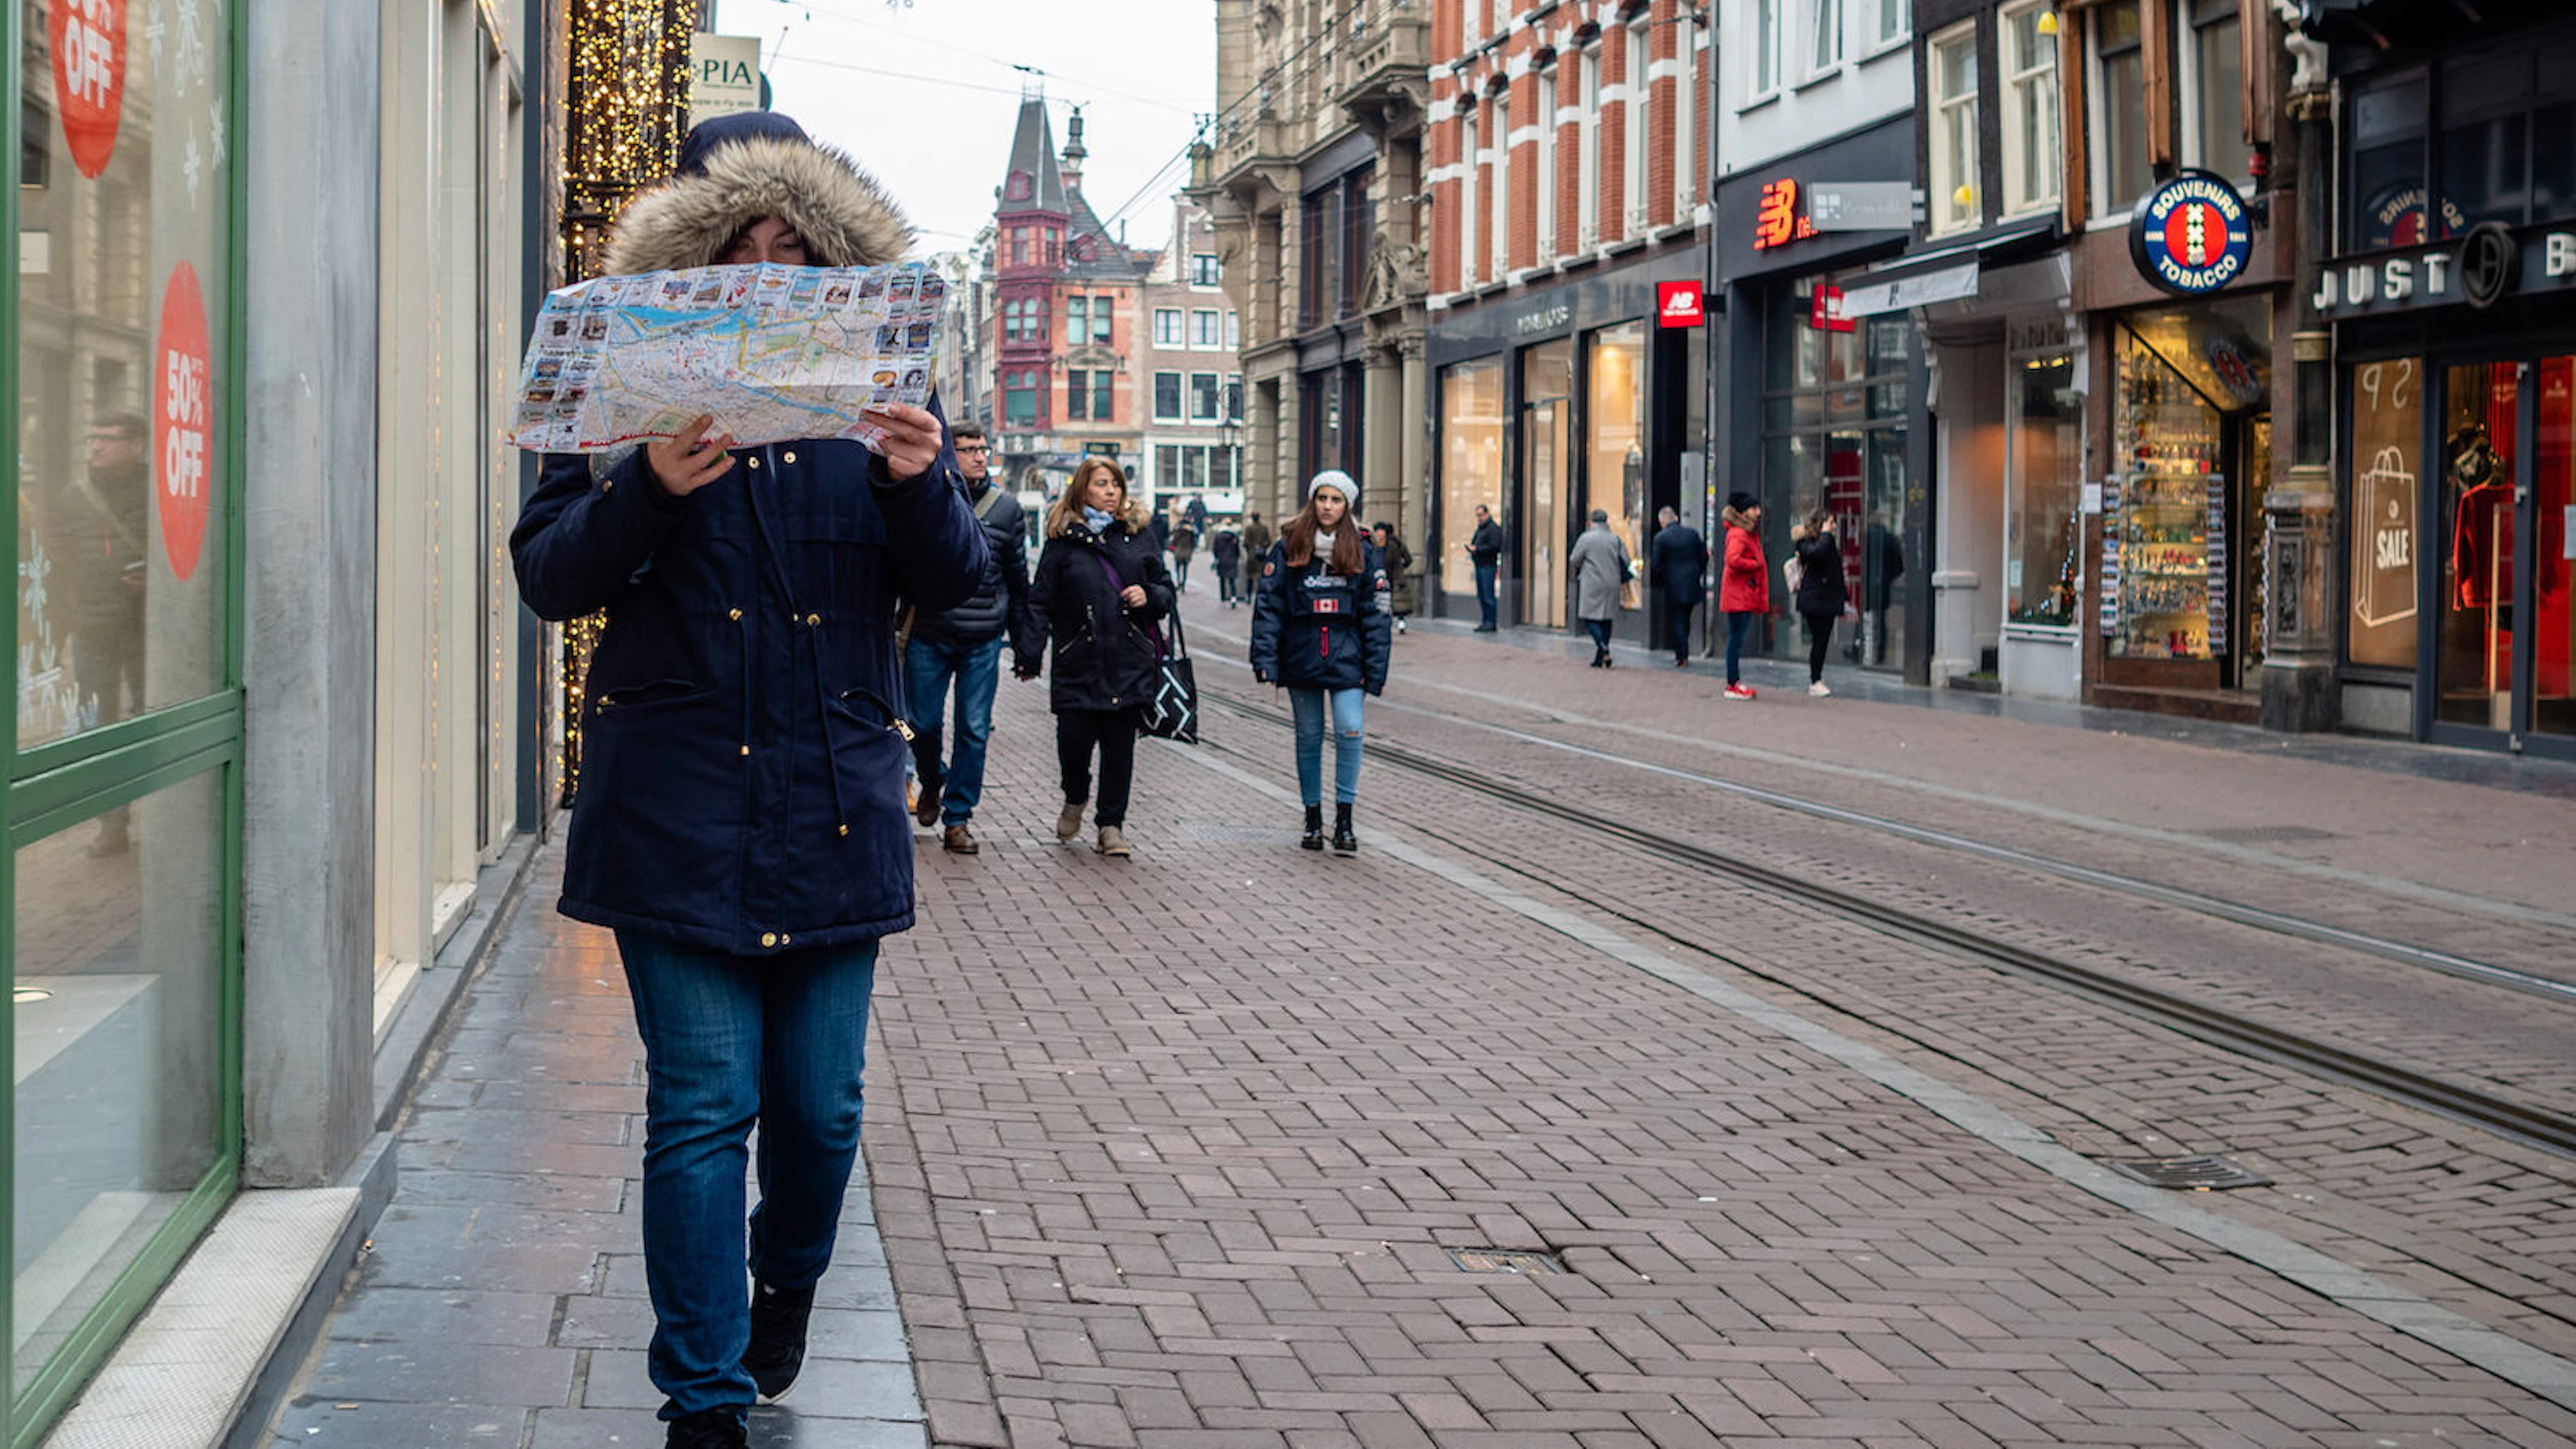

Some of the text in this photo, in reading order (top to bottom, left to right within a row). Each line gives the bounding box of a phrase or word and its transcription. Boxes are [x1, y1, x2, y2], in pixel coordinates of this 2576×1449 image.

[65, 15, 111, 109] OFF
[692, 59, 751, 85] PIA
[2151, 180, 2241, 221] SOUVENIRS
[2159, 254, 2237, 288] TOBACCO
[2314, 253, 2451, 309] JUST
[168, 349, 203, 425] 50%
[166, 425, 203, 498] OFF
[2377, 528, 2410, 570] SALE
